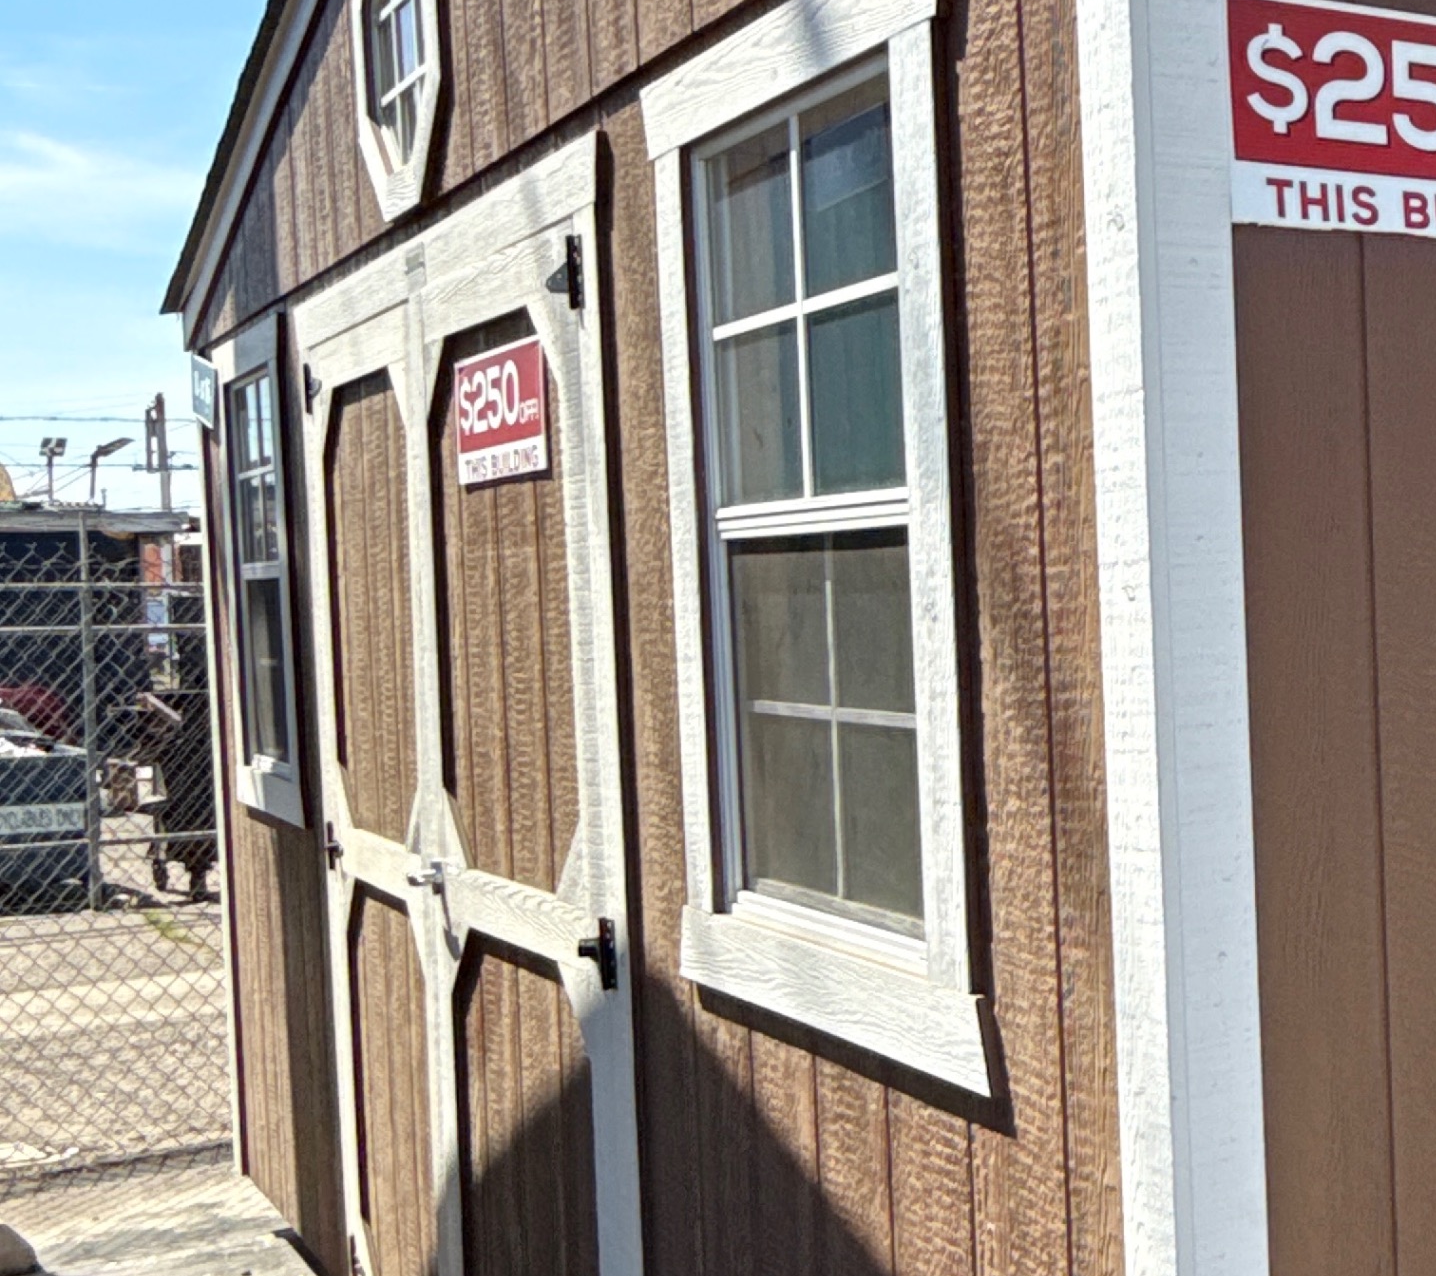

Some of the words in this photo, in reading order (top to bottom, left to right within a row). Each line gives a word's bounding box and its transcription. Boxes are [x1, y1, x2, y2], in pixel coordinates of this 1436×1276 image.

[1265, 177, 1379, 225] THIS
[460, 359, 520, 436] $250
[464, 455, 488, 481] THIS
[490, 444, 539, 478] BUILDING
